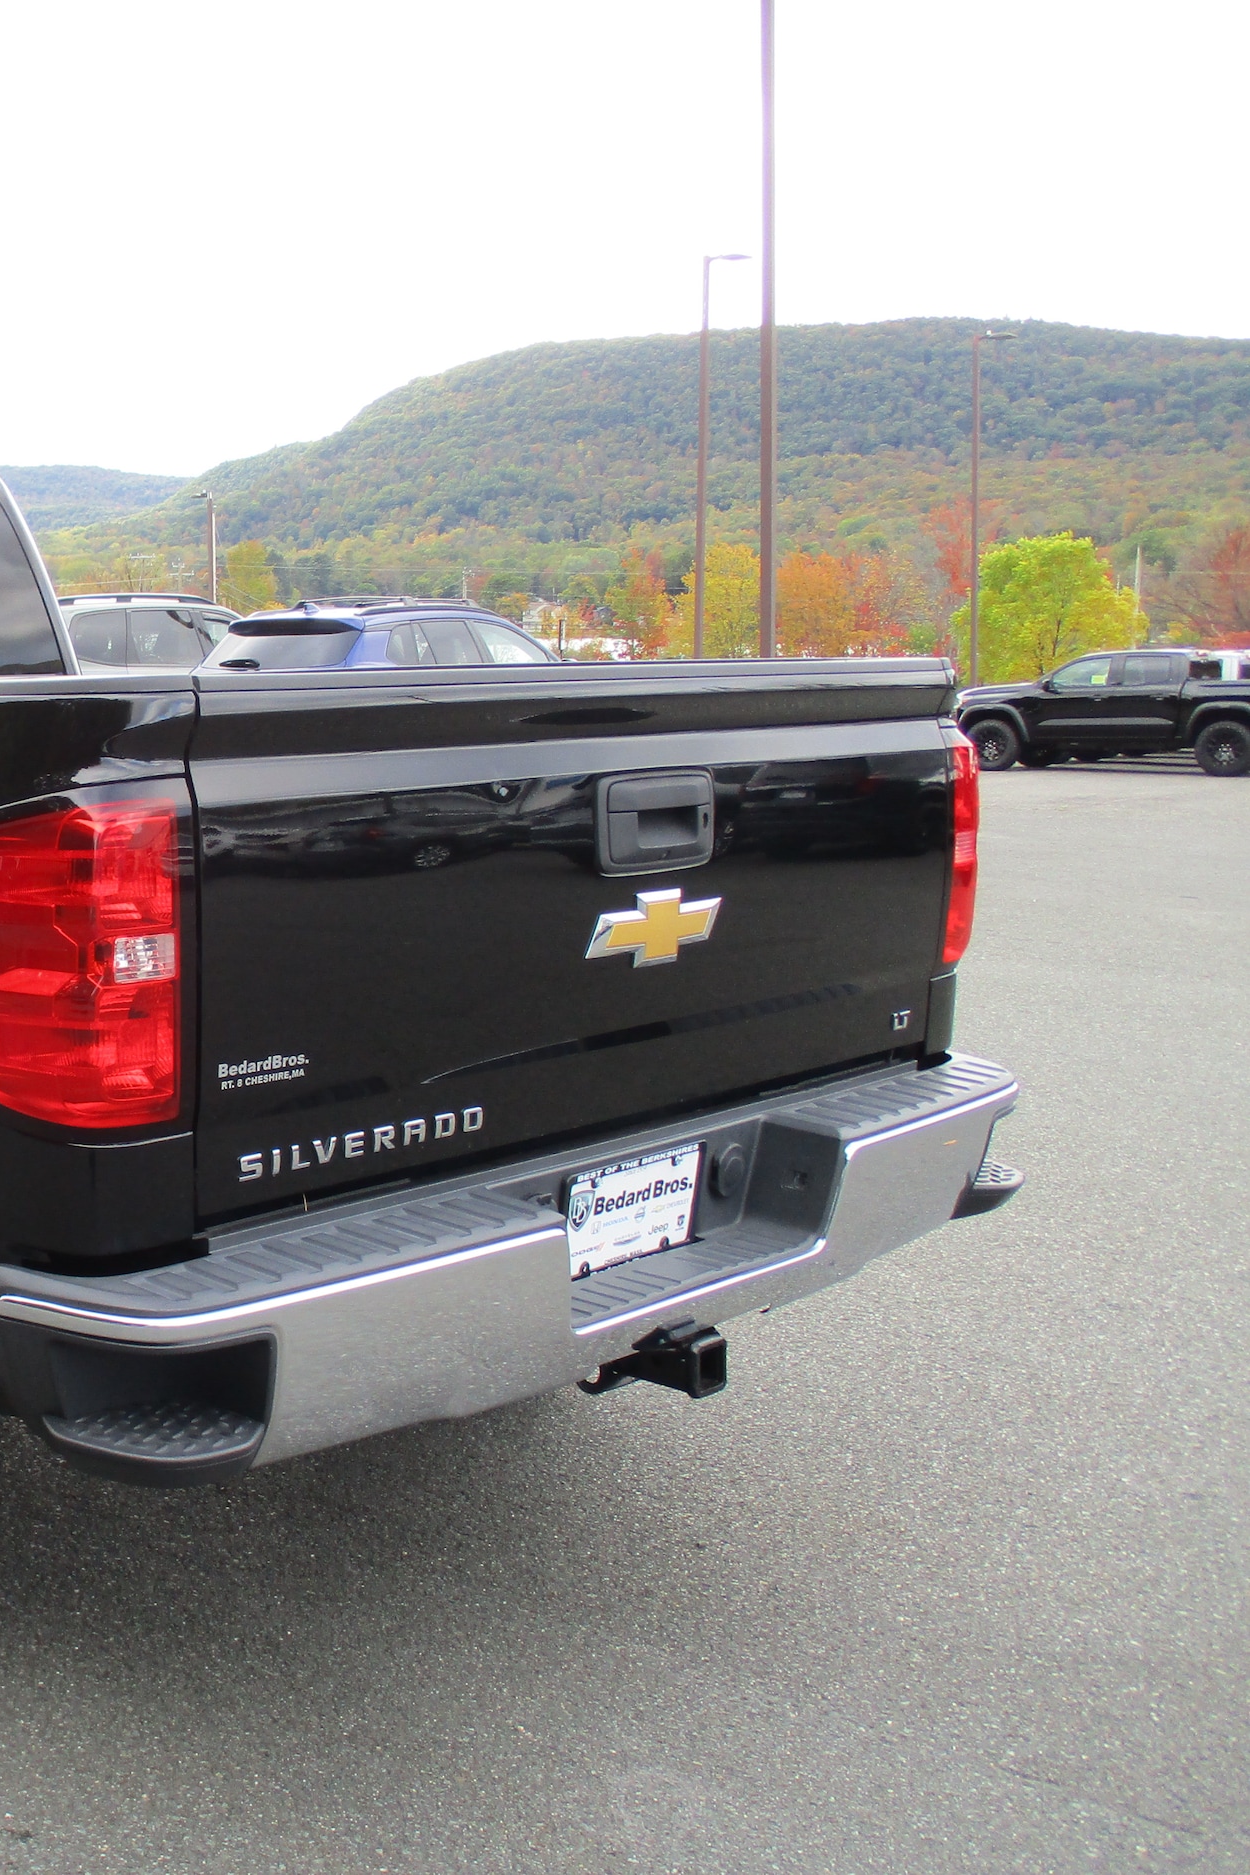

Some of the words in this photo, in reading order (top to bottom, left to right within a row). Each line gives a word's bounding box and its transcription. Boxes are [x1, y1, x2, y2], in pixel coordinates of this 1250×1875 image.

[892, 1010, 911, 1031] LT
[221, 1080, 235, 1090] RT.
[237, 1078, 243, 1088] 8
[238, 1106, 484, 1182] SILVERADO
[577, 1169, 604, 1182] BEST
[604, 1165, 619, 1175] OF
[620, 1159, 639, 1170] THE
[641, 1143, 699, 1165] BERKSHIRES
[594, 1182, 652, 1215] Bedard
[653, 1176, 693, 1199] Bros.
[647, 1222, 669, 1236] Jeep
